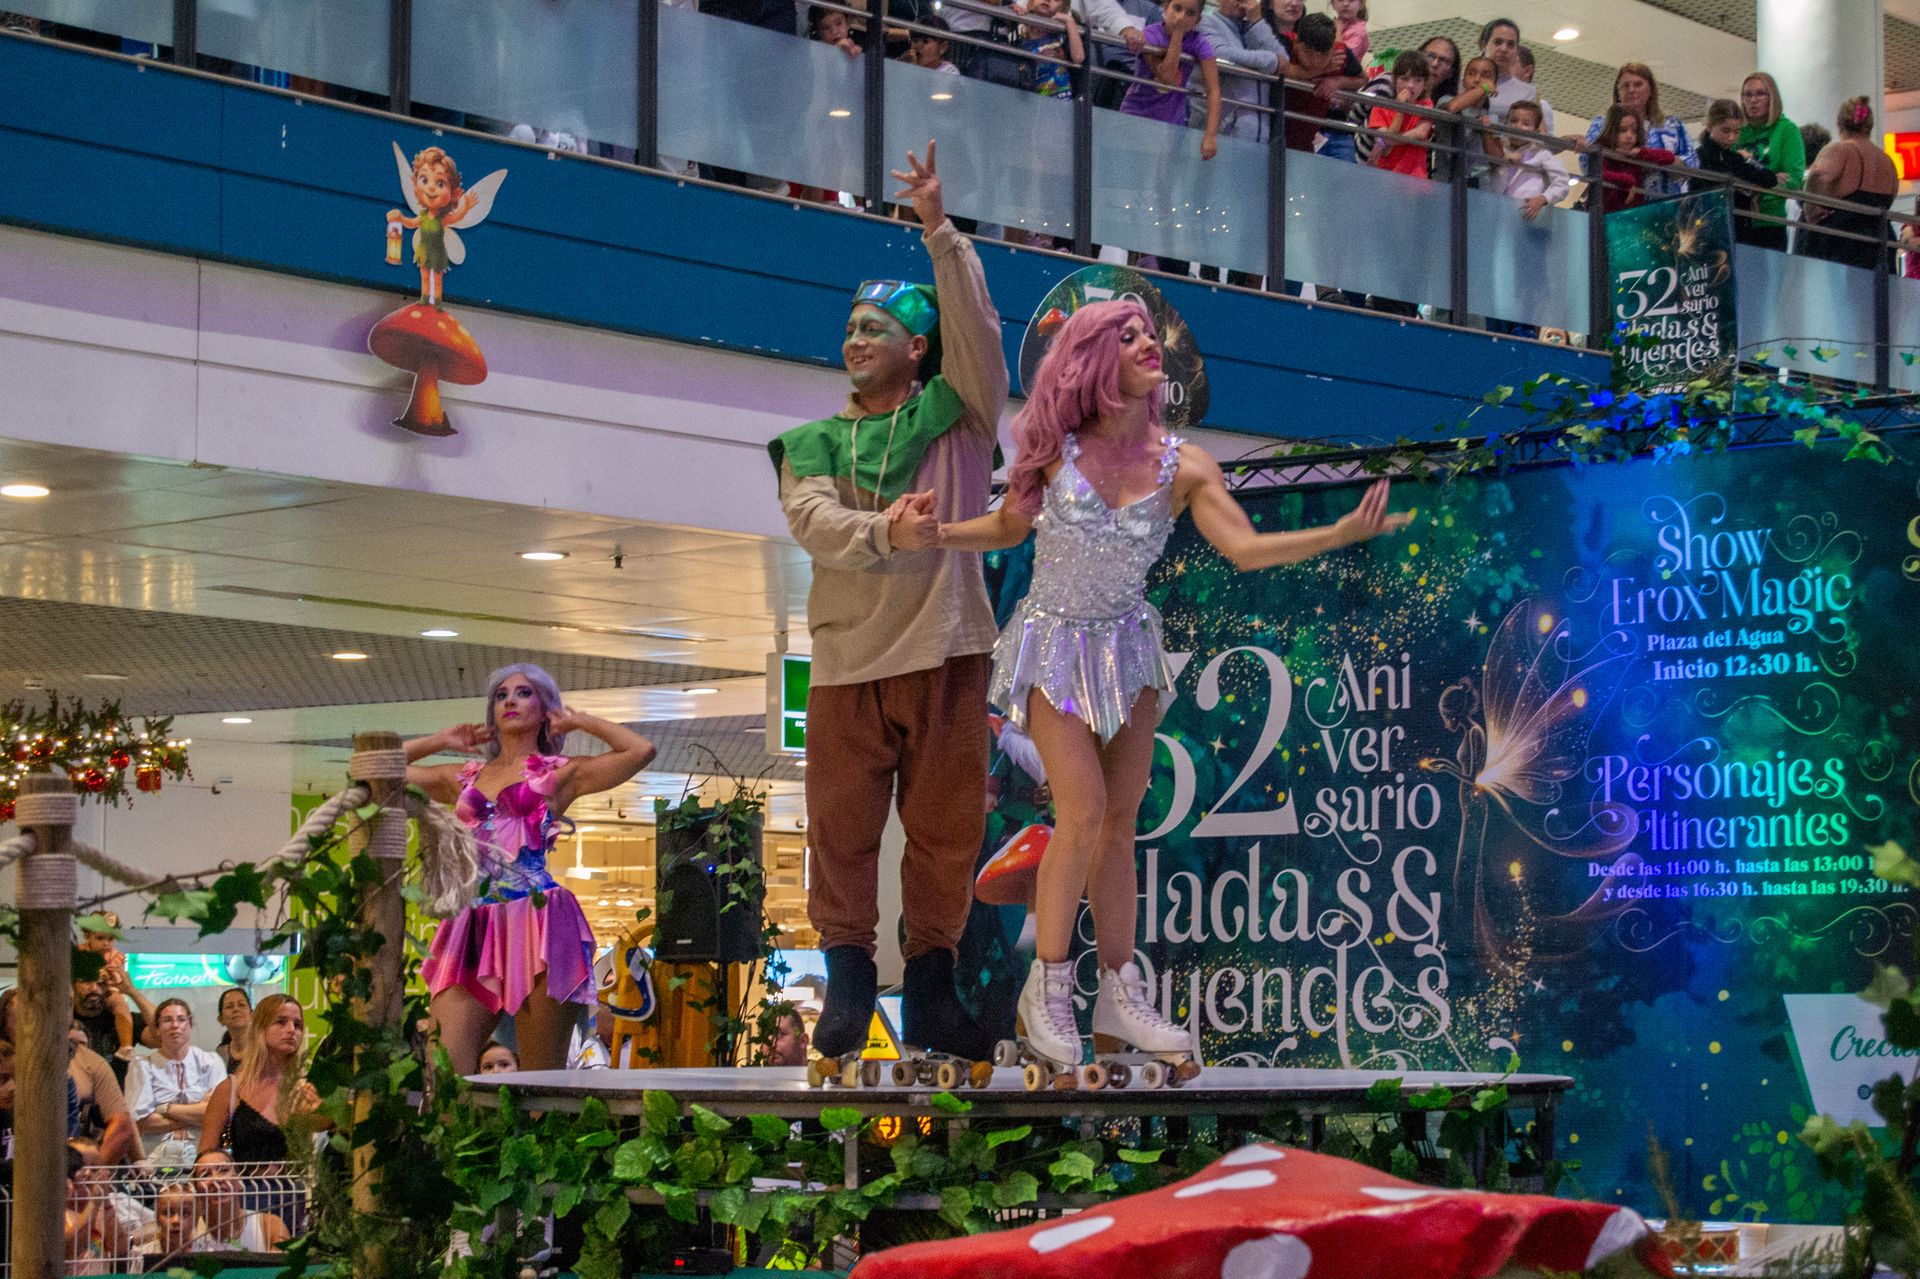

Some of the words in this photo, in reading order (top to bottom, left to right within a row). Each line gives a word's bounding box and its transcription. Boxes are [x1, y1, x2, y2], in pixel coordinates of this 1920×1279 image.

[1680, 263, 1709, 285] Ani
[1684, 282, 1708, 297] ver
[1616, 266, 1679, 319] 32
[1680, 295, 1719, 315] sario
[1701, 311, 1718, 338] &
[1612, 574, 1709, 625] Erox
[1722, 566, 1852, 635] Magic
[1648, 634, 1698, 651] Plaza
[1703, 629, 1731, 648] del
[1735, 628, 1785, 649] Agua
[1653, 658, 1719, 680] Inicio
[1725, 652, 1790, 677] 12:30
[1795, 652, 1819, 673] h.
[1305, 652, 1410, 728] Ani
[1320, 724, 1405, 773] ver
[1586, 751, 1845, 807] Personajes
[1304, 773, 1441, 837] sario
[1638, 808, 1849, 850] Itinerantes
[1588, 861, 1634, 877] Desde
[1639, 861, 1662, 876] las
[1666, 860, 1710, 875] 11:00
[1714, 860, 1730, 874] h.
[1735, 858, 1780, 873] hasta
[1784, 857, 1809, 872] las
[1813, 855, 1863, 871] 13:00
[1387, 846, 1441, 951] &
[1603, 887, 1614, 902] y
[1617, 884, 1661, 899] desde
[1665, 883, 1689, 898] las
[1693, 881, 1738, 897] 16:30
[1742, 881, 1758, 896] h.
[1763, 880, 1807, 895] hasta
[1811, 880, 1836, 895] las
[1840, 878, 1887, 894] 19:30
